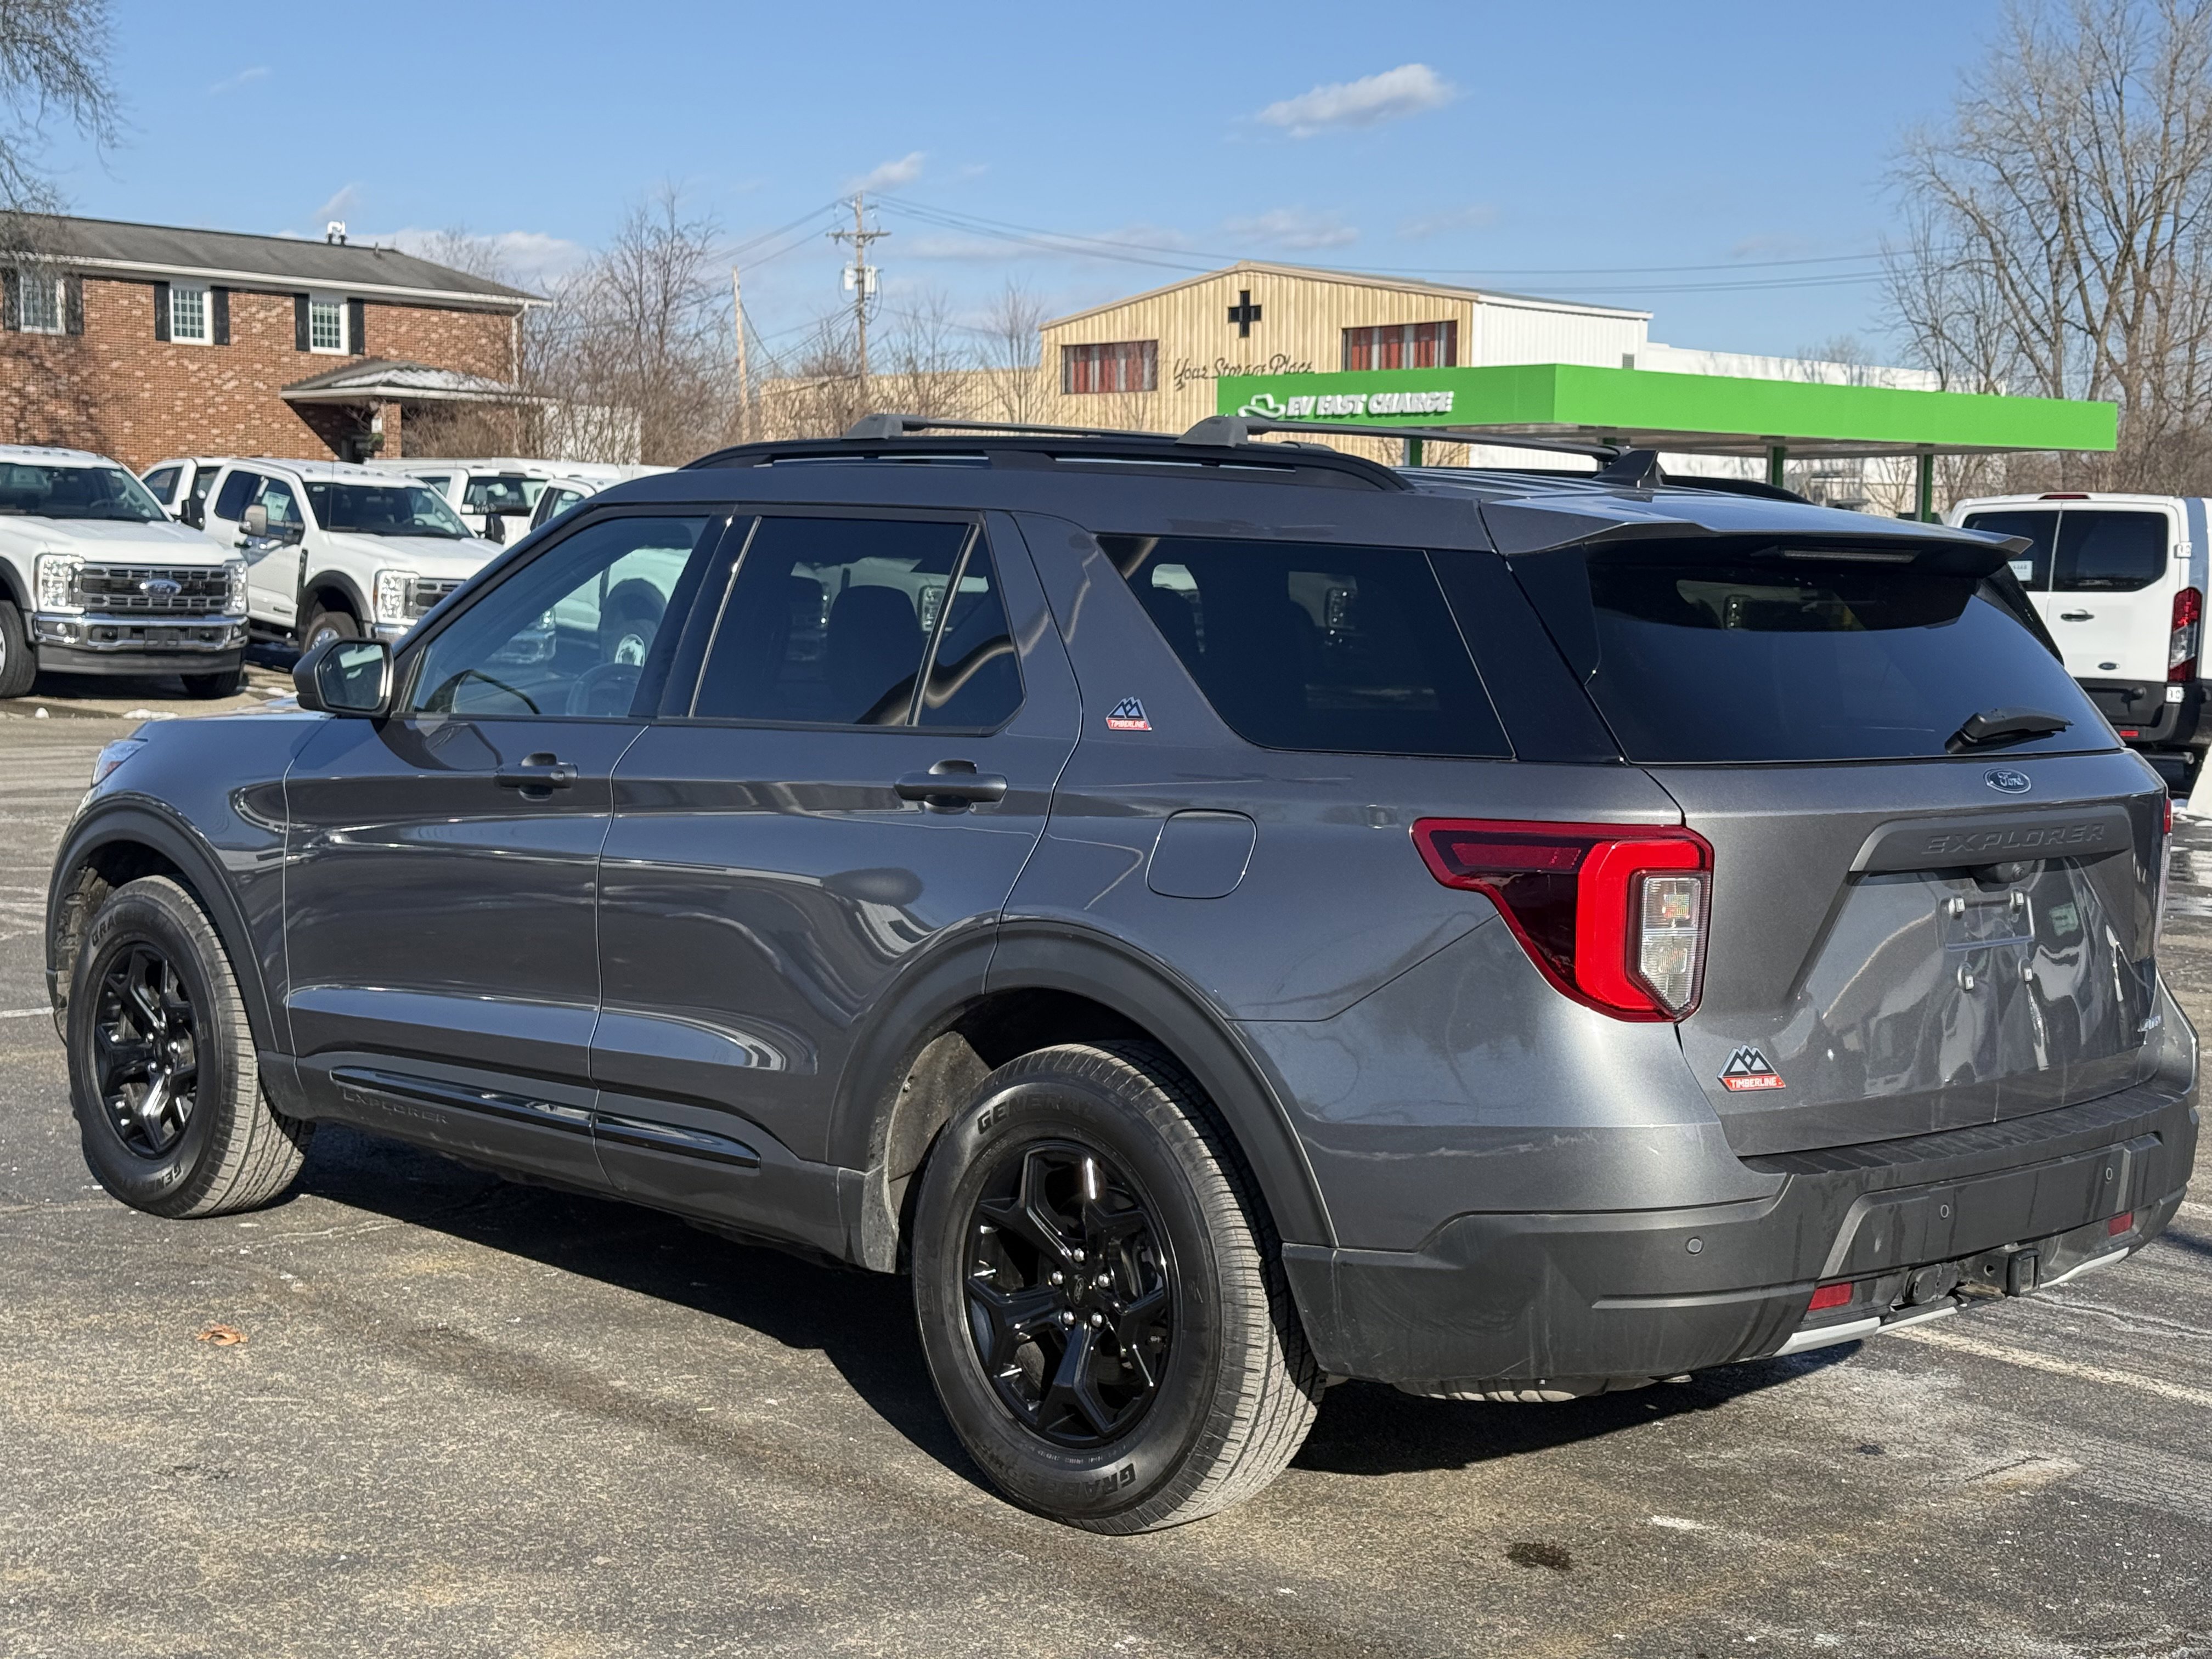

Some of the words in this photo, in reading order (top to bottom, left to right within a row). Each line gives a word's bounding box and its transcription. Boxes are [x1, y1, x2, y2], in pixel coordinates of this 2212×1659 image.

[1173, 357, 1209, 392] Your
[1269, 353, 1316, 375] Place
[1286, 395, 1316, 416] EV
[1316, 393, 1368, 415] FAST
[1368, 391, 1454, 414] CHARGE
[1997, 772, 2024, 787] Ford
[1921, 823, 2105, 855] EXPLORER
[1730, 1076, 1778, 1089] TIMBERLINE
[343, 1088, 449, 1125] EXPLORER
